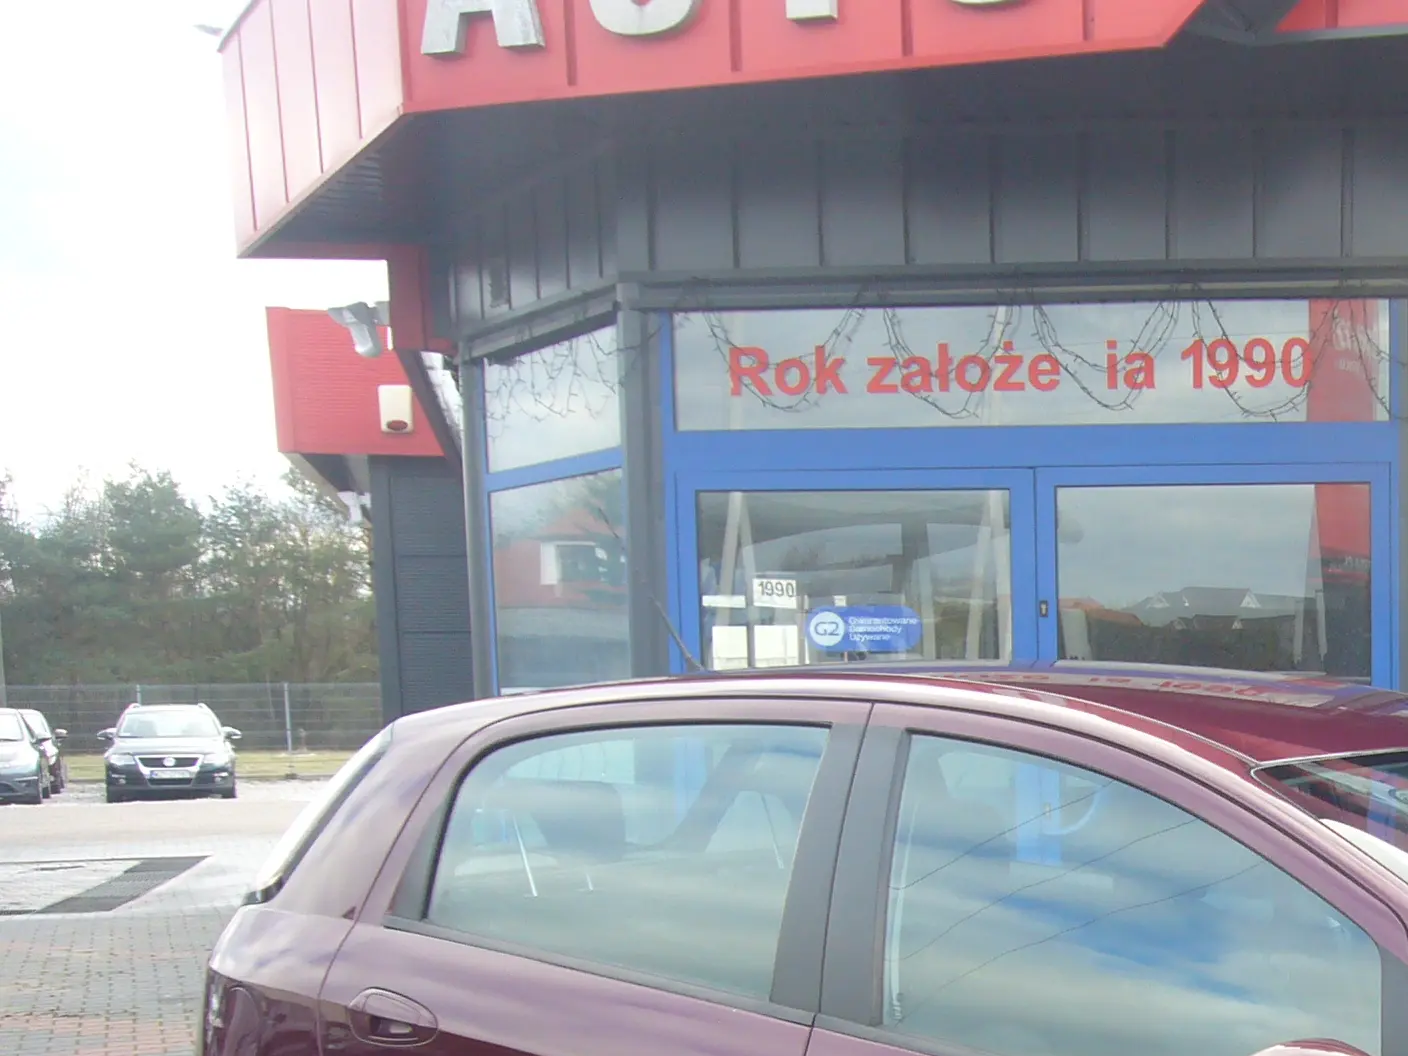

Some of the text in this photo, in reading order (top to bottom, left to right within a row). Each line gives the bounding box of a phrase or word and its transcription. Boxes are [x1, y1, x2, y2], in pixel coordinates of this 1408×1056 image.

[729, 345, 848, 397] Rok
[1180, 337, 1313, 389] 1990
[757, 580, 795, 598] 1990
[814, 621, 840, 636] G2
